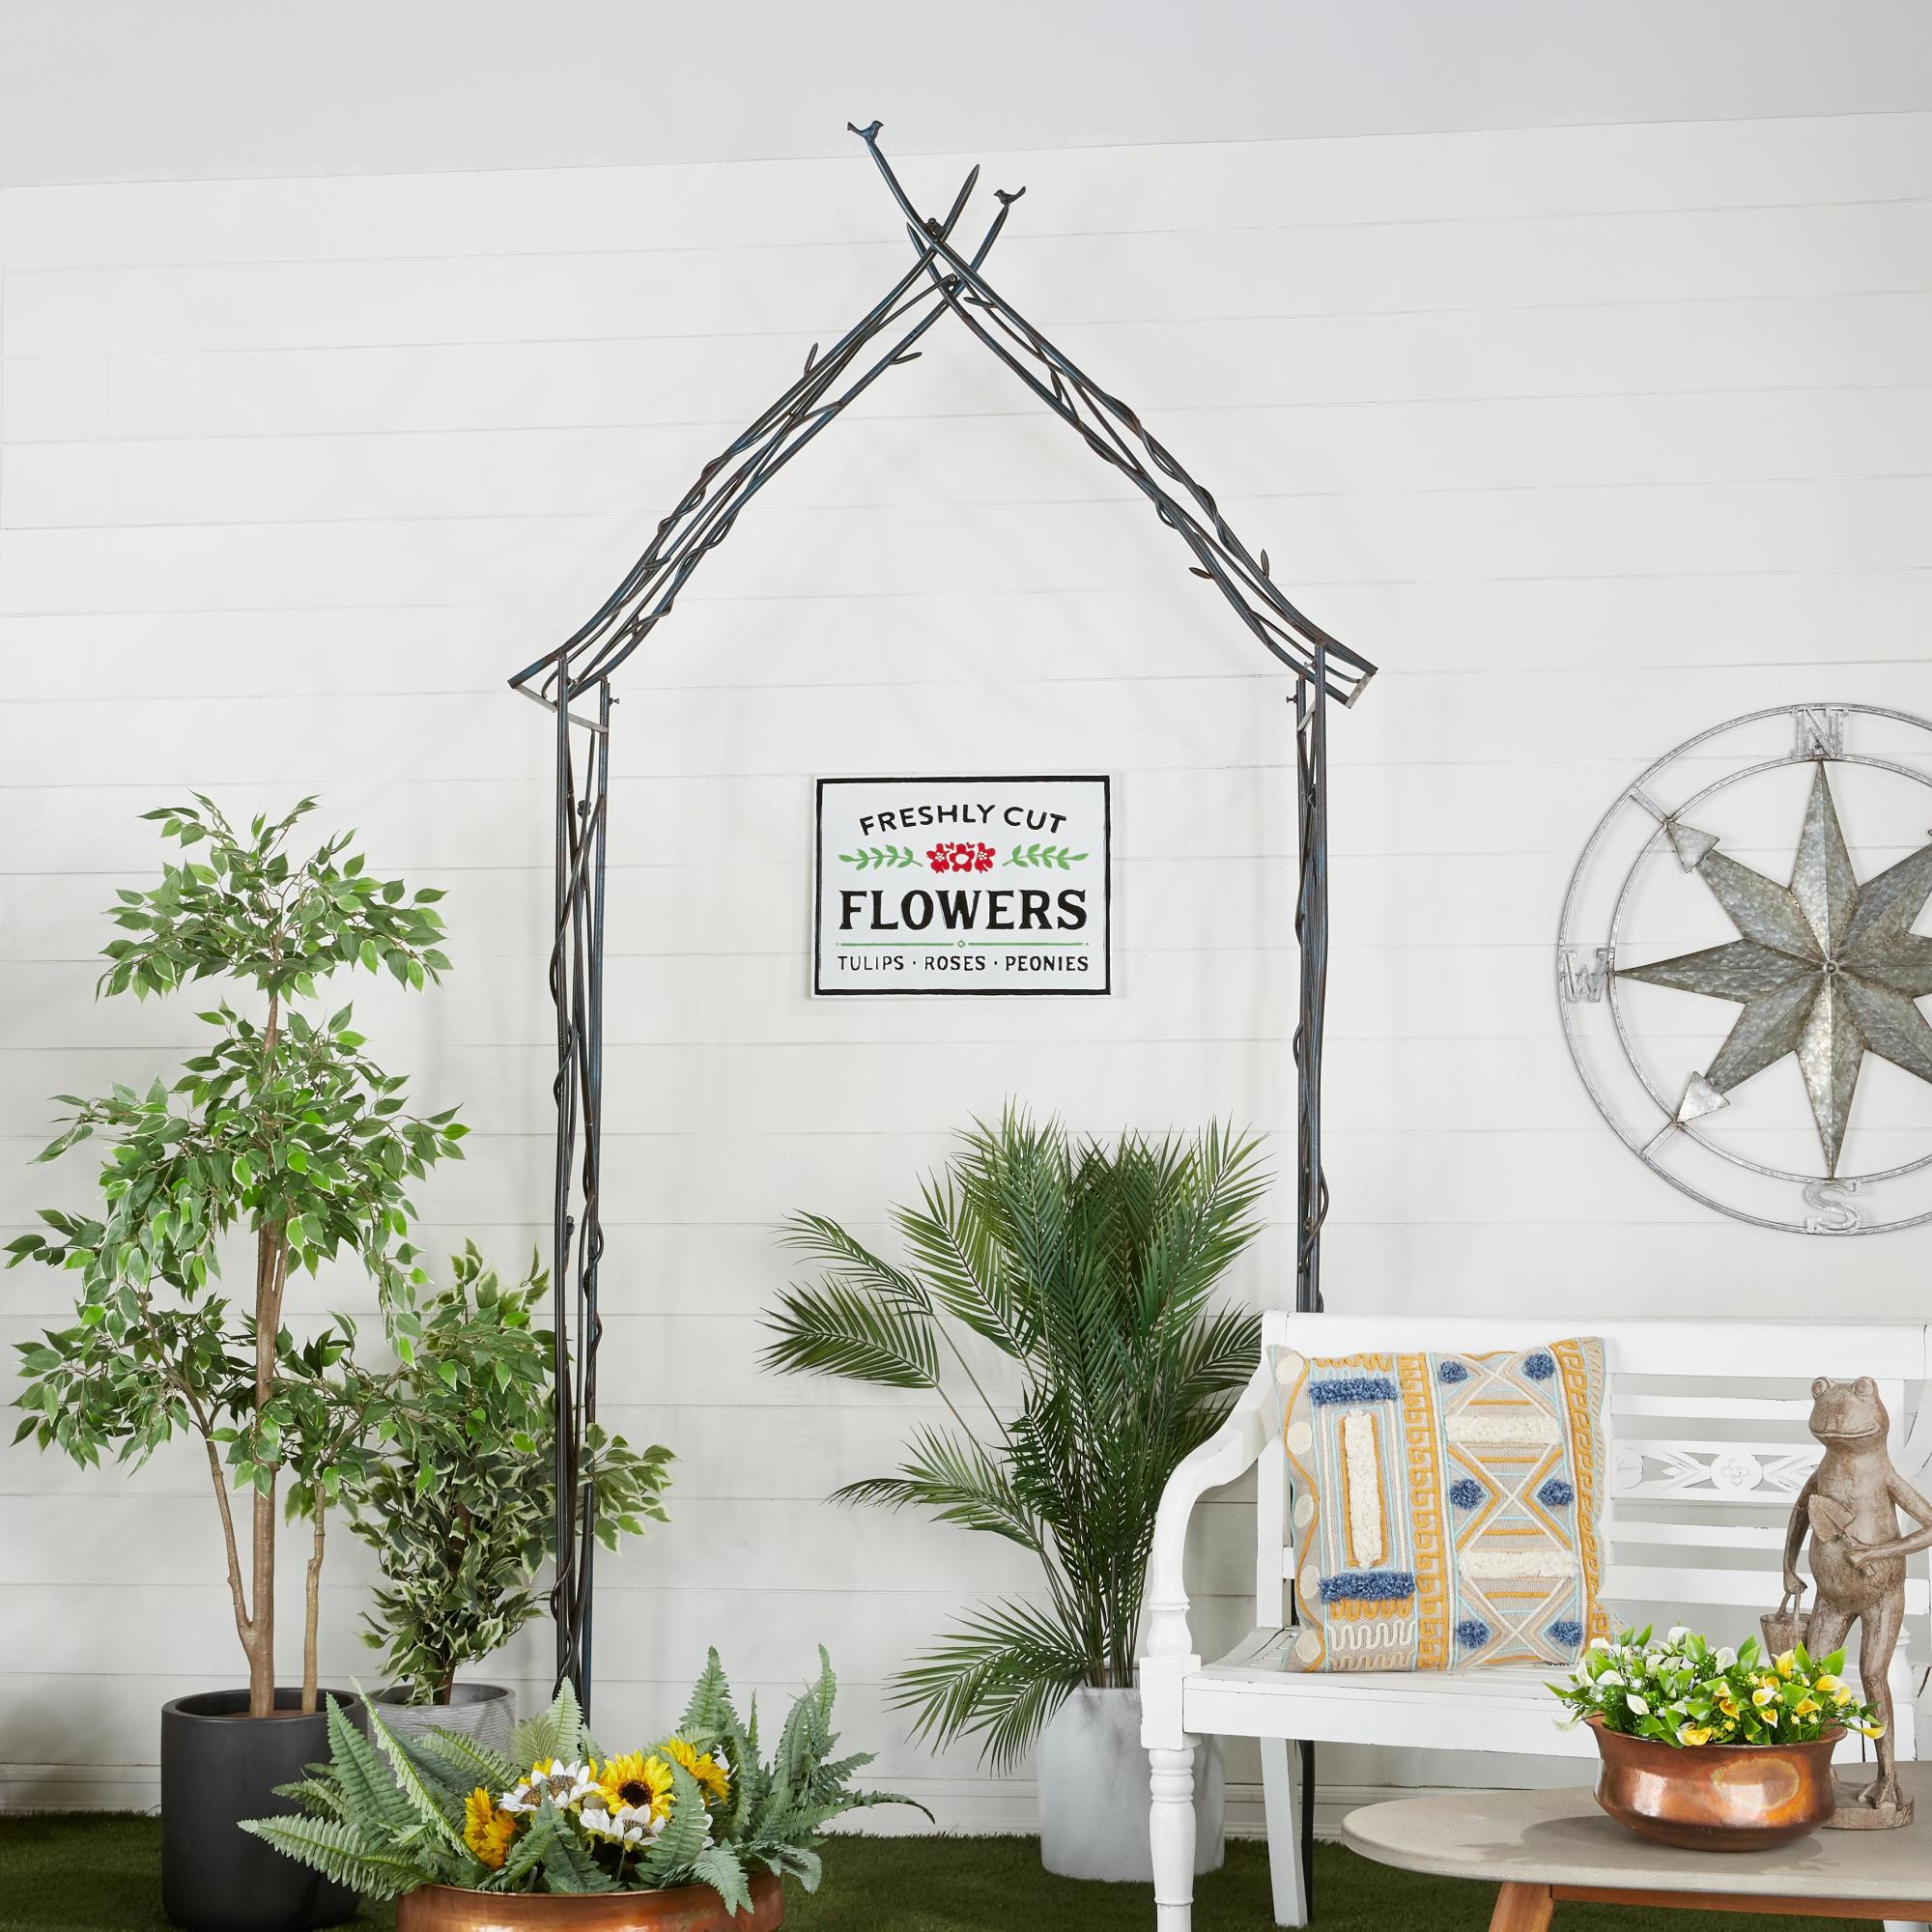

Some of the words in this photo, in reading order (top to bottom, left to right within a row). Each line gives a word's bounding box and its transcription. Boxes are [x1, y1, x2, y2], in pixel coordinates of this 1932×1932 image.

[1791, 707, 1849, 760] N
[859, 803, 996, 837] FRESHLY
[1003, 806, 1067, 834] CUT
[838, 889, 1088, 931] FLOWERS
[837, 954, 904, 972] TULIPS
[924, 955, 986, 972] ROSES
[1005, 954, 1089, 972] PEONIES
[1558, 945, 1616, 1004] W
[1804, 1179, 1862, 1236] S
